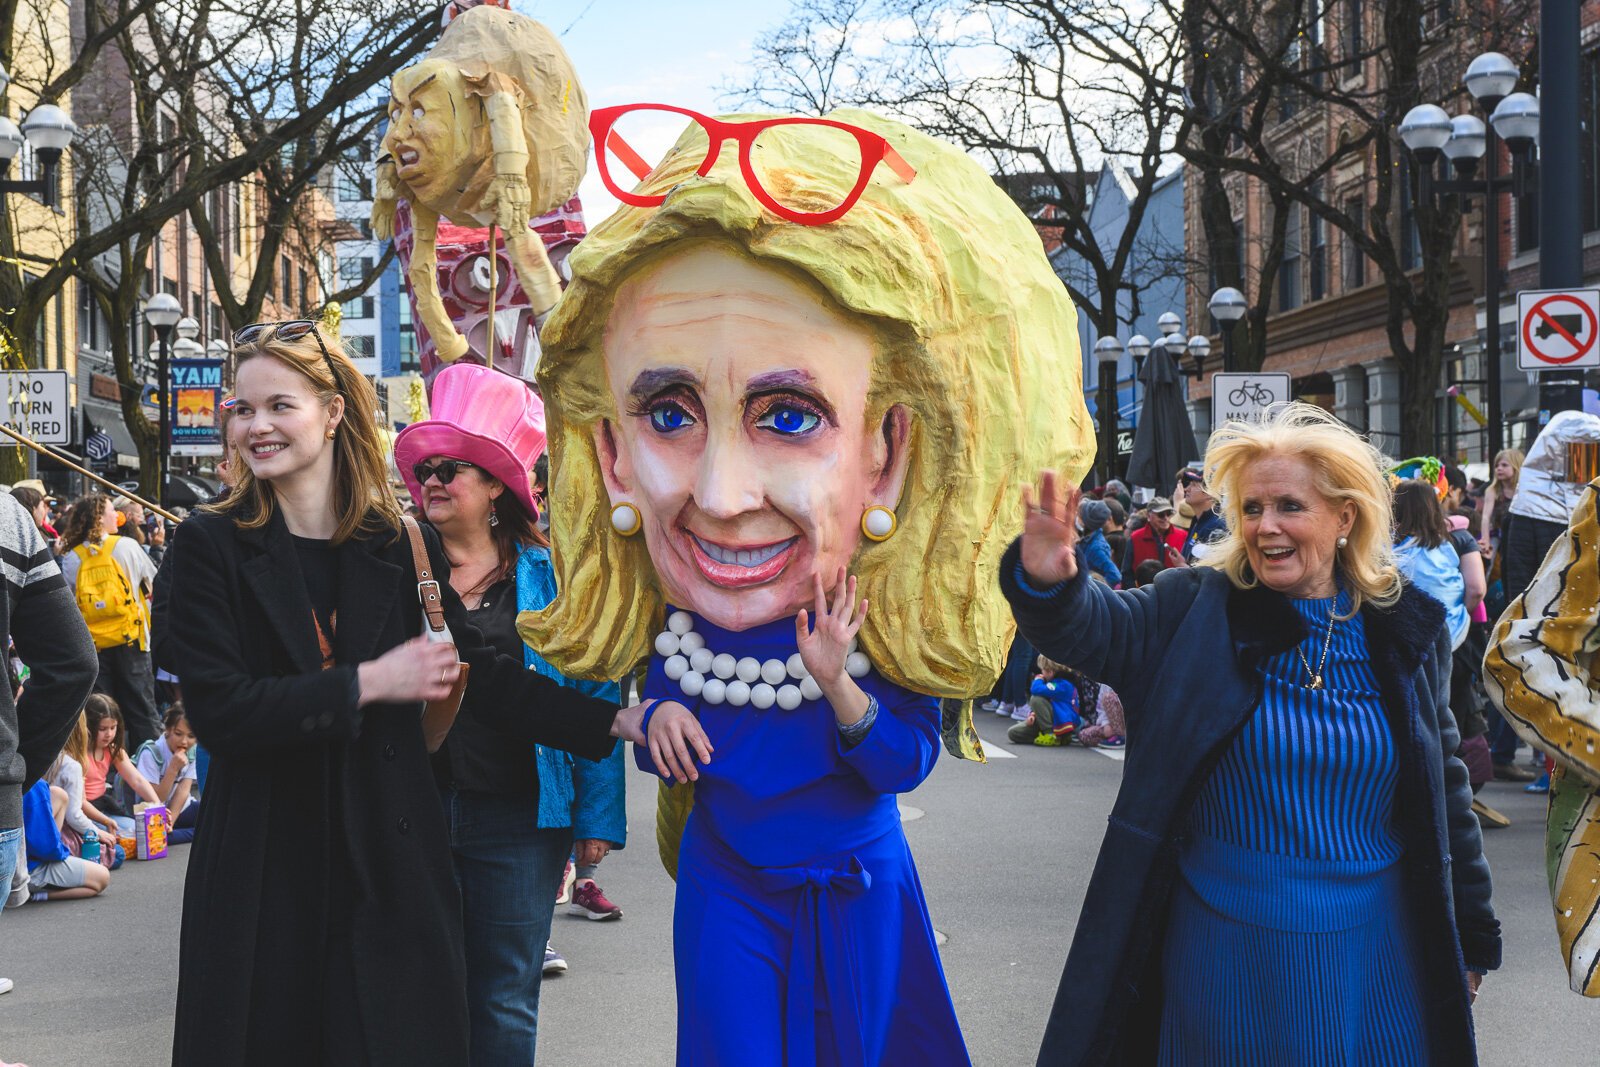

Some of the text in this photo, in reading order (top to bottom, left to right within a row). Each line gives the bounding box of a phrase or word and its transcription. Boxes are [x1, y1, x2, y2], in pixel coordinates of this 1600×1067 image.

[172, 367, 221, 384] YAM
[19, 381, 43, 394] NO
[12, 401, 52, 414] TURN
[1226, 412, 1249, 422] MAY
[32, 422, 61, 435] RED
[172, 428, 220, 436] DOWNTOWN
[1117, 432, 1134, 451] The
